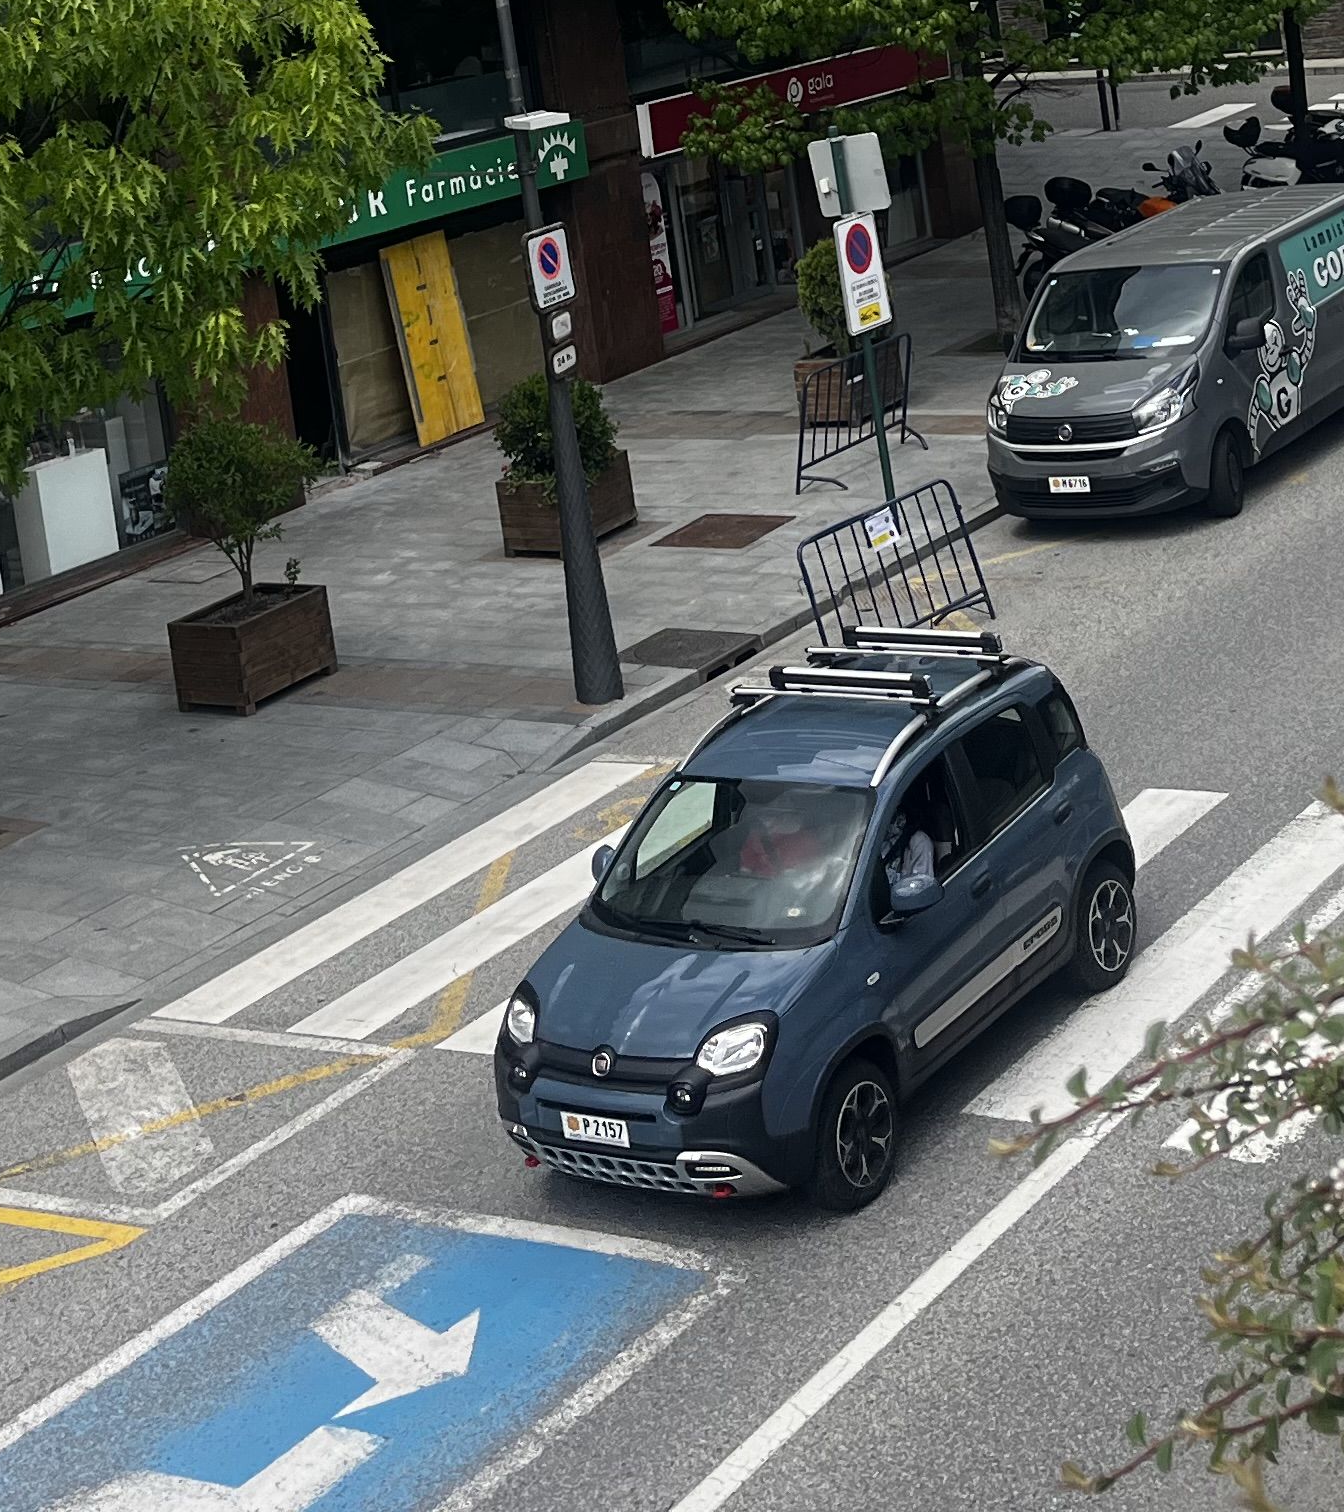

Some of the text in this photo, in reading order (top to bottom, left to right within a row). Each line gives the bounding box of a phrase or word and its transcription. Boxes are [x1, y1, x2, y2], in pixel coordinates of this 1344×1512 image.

[1276, 387, 1292, 419] G
[582, 1117, 623, 1139] P 2157
